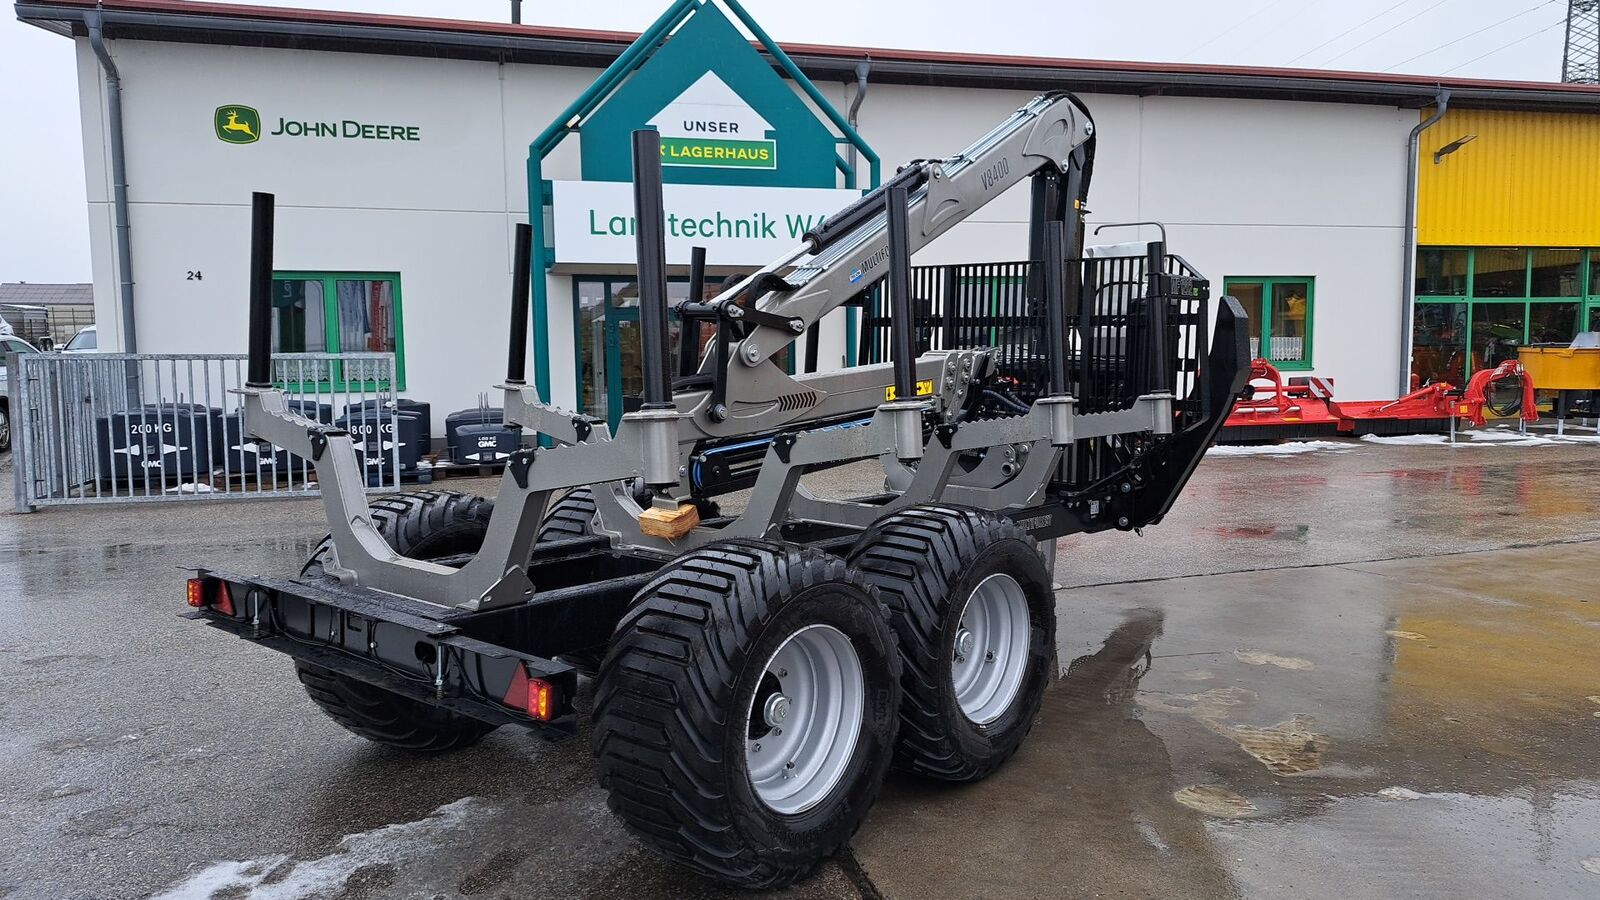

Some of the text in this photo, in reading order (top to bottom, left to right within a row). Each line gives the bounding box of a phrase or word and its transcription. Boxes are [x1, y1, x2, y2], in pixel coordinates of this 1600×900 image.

[271, 117, 420, 141] JOHN DEERE
[683, 120, 739, 133] UNSER
[670, 145, 769, 160] LAGERHAUS
[980, 157, 1009, 190] V8400
[186, 270, 203, 281] 24
[130, 422, 173, 434] 200 KG
[351, 424, 373, 434] 800
[478, 440, 497, 448] GMC
